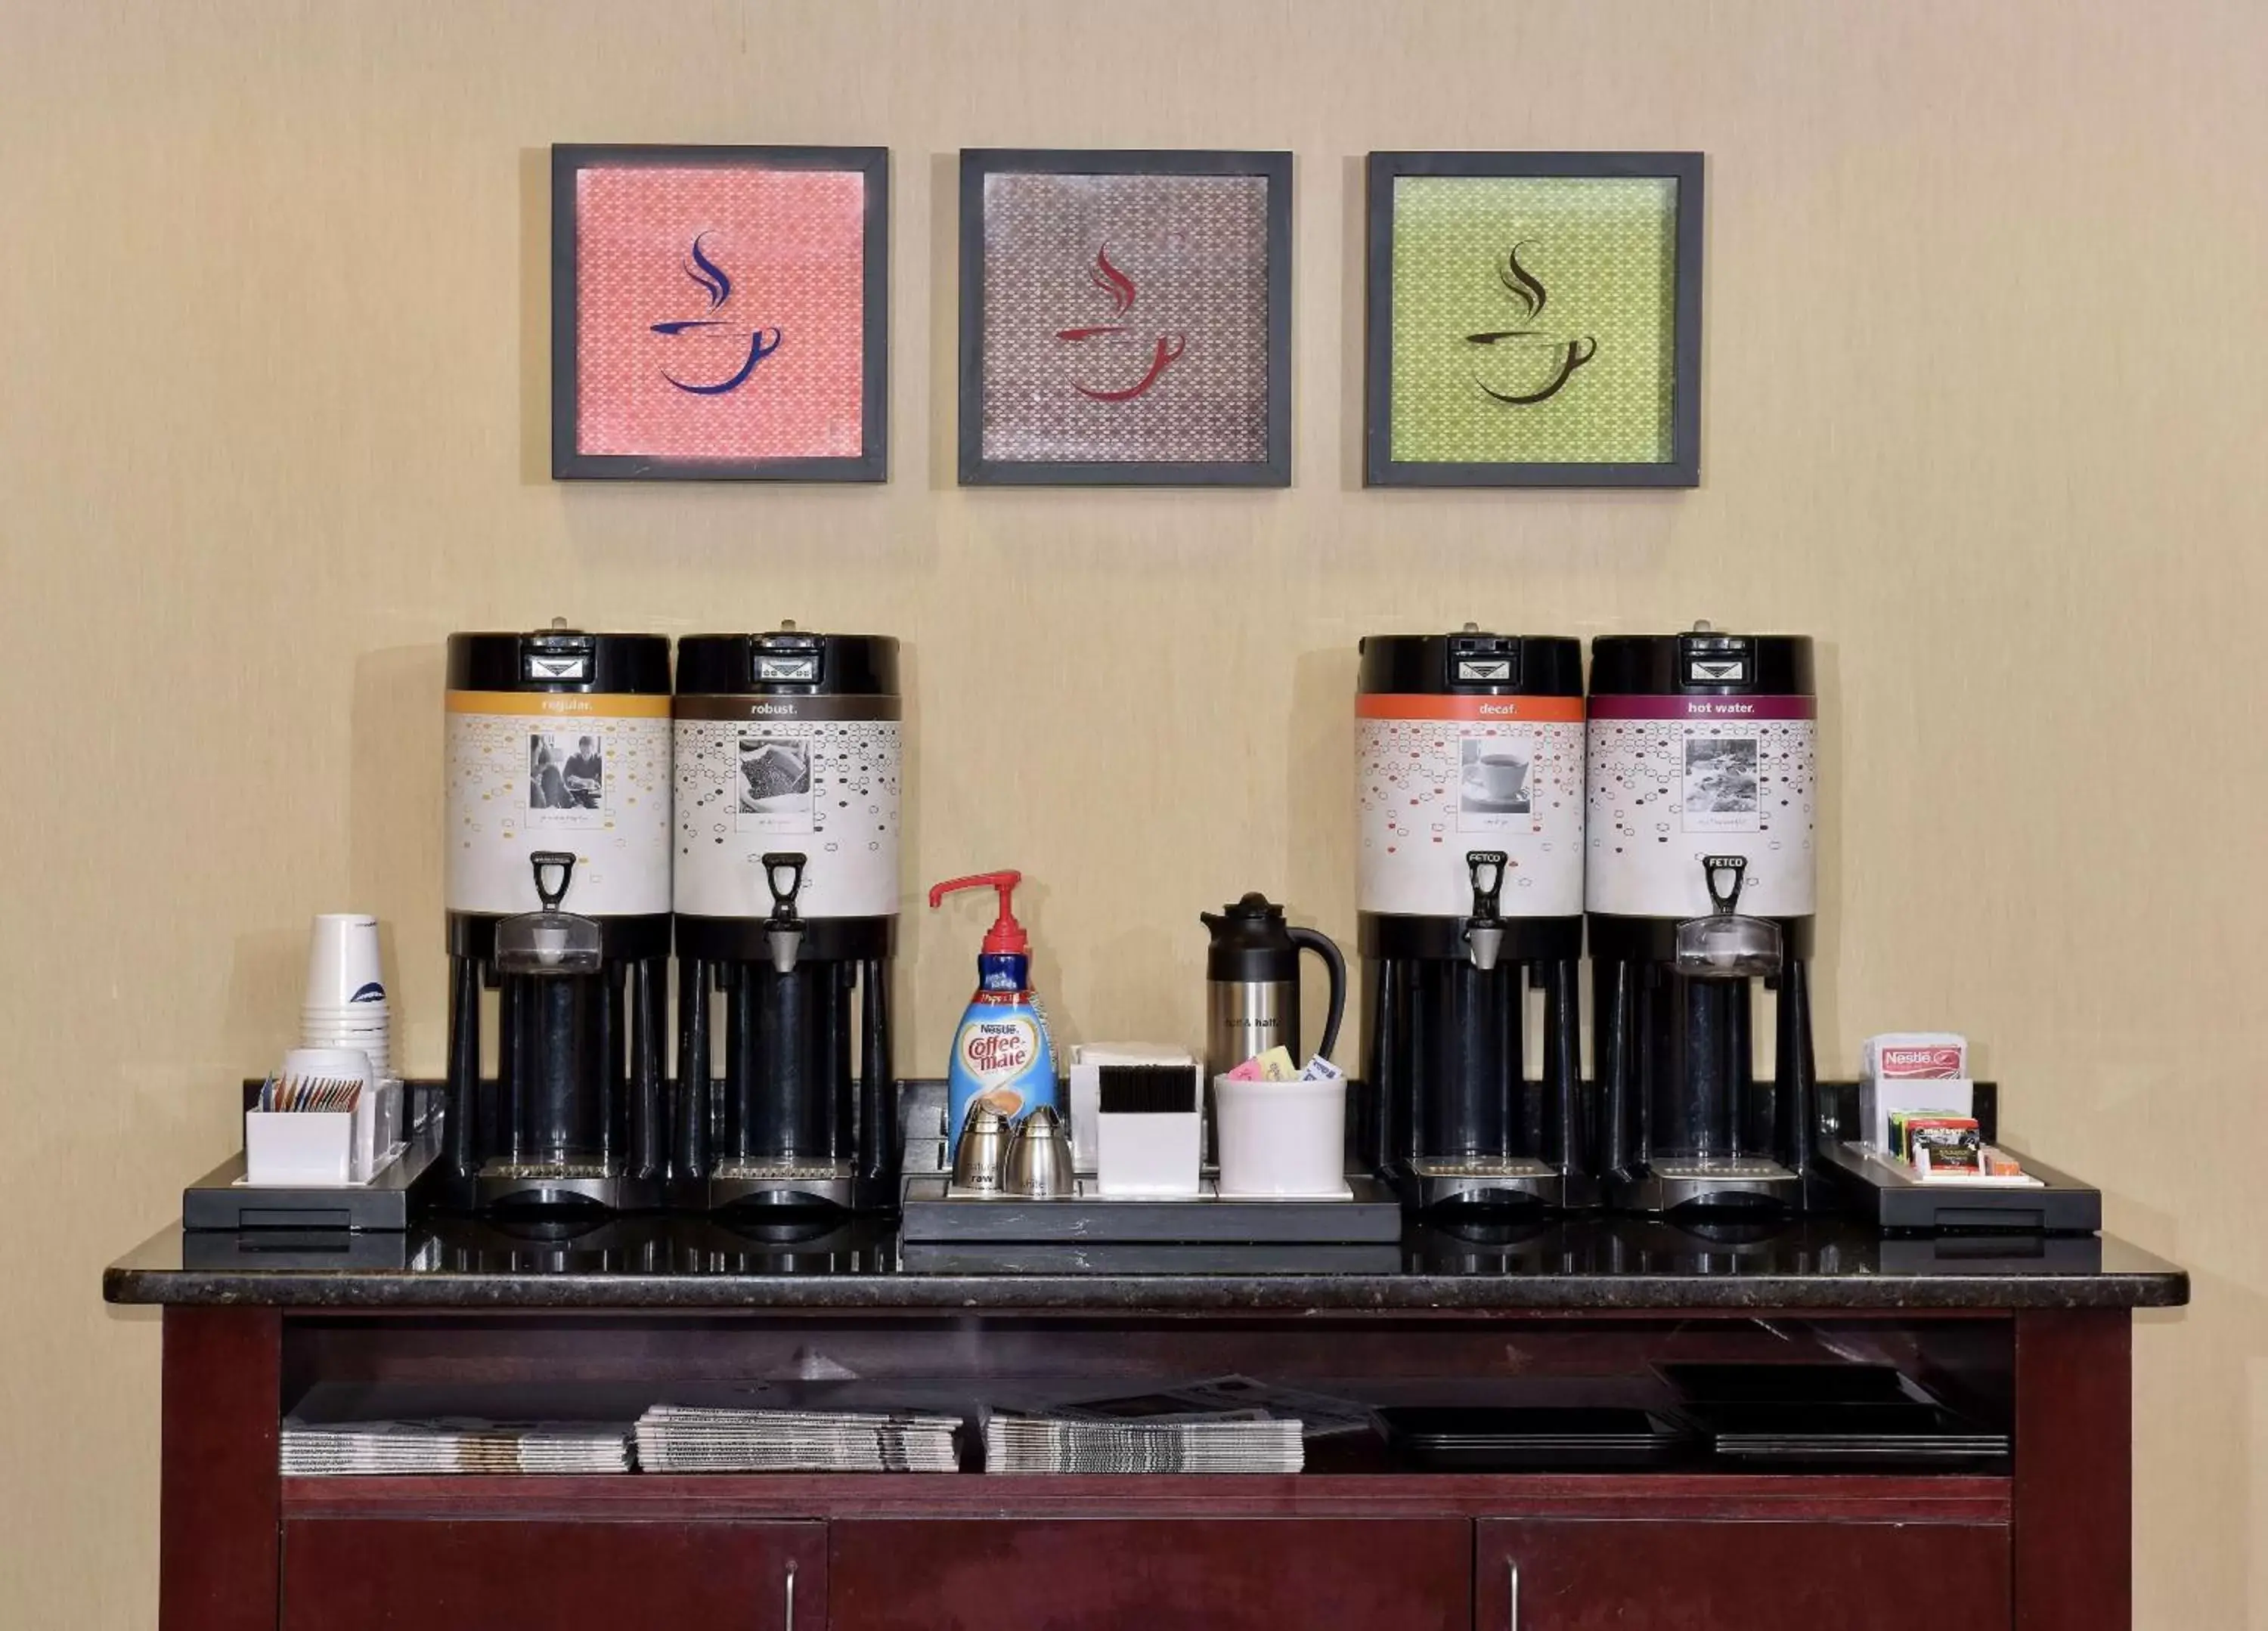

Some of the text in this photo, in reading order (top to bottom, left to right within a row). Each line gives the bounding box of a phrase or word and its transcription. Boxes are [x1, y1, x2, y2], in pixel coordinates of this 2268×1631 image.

[751, 702, 798, 714] robust.
[1479, 703, 1518, 714] decaf.
[1687, 701, 1755, 713] hot water.
[1469, 853, 1501, 862] FETCO
[1709, 857, 1743, 867] FETCO
